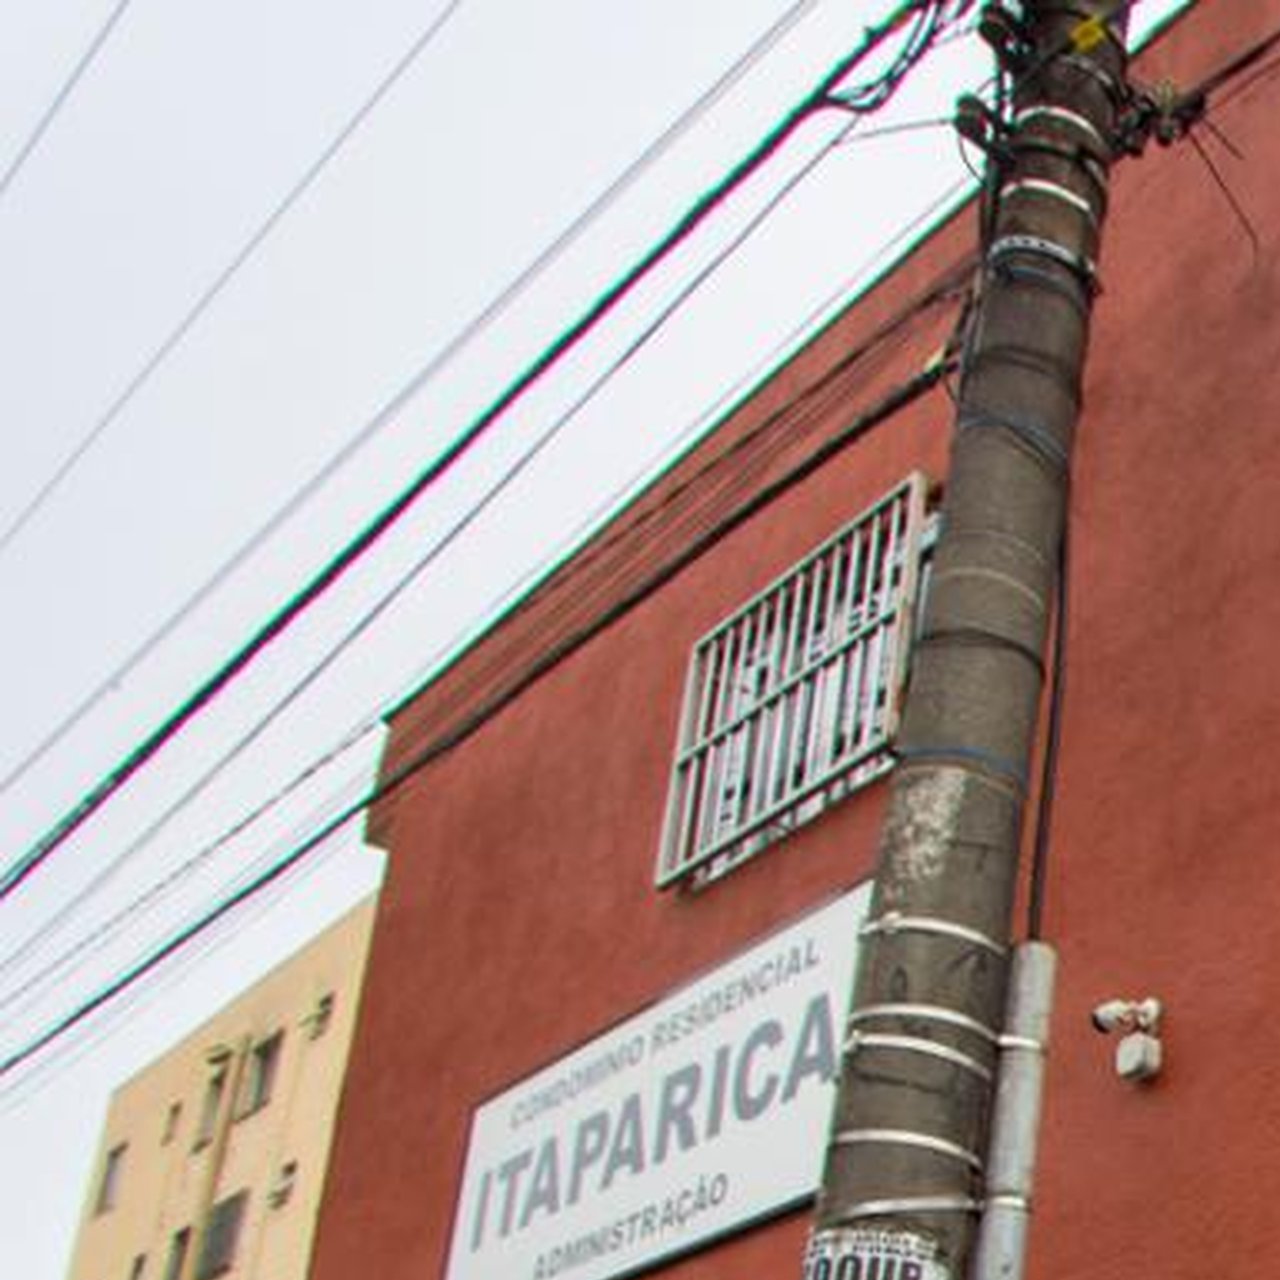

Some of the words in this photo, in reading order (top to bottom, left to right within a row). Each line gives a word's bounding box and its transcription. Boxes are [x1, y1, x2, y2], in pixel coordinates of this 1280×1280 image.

[651, 939, 819, 1049] RESIDENCIAL
[470, 992, 838, 1252] ITAPARICA
[532, 1172, 728, 1280] ADMINISTRAÇÃO
